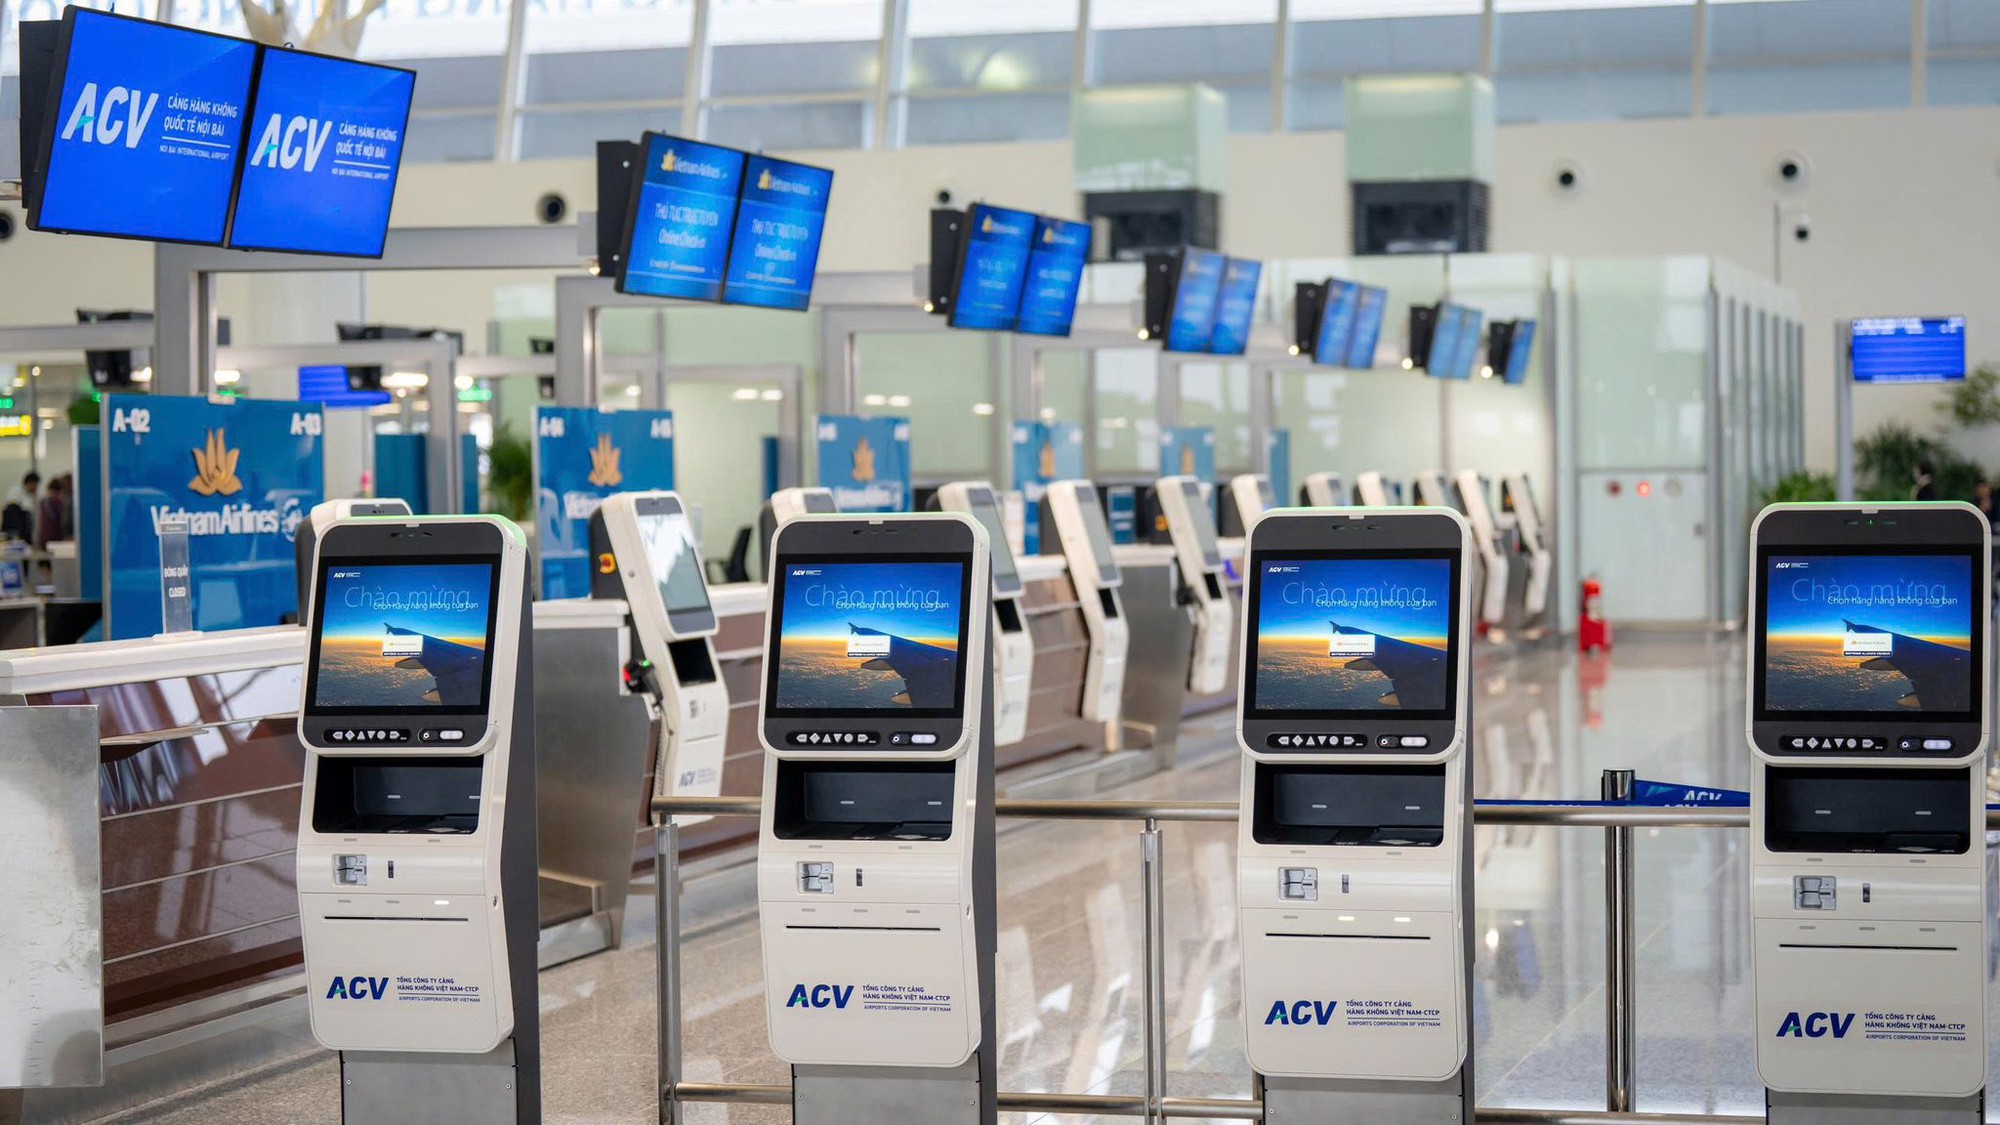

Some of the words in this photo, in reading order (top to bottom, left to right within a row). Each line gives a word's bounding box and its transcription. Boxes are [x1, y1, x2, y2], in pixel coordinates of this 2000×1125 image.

[61, 82, 159, 148] ACV
[250, 113, 333, 173] ACV
[112, 408, 150, 432] A-02
[221, 503, 279, 533] Airlines
[344, 584, 400, 608] Chào
[408, 584, 470, 612] mừng
[805, 584, 865, 607] Chào
[874, 583, 940, 612] mừng
[1282, 581, 1346, 605] Chào
[1356, 581, 1427, 610] mừng
[1791, 577, 1860, 602] Chào
[1871, 578, 1946, 608] mừng
[326, 976, 389, 1000] ACV
[396, 976, 412, 984] TỔNG
[414, 984, 434, 992] KHÔNG
[435, 984, 448, 992] VIỆT
[862, 983, 879, 992] TỔNG
[880, 984, 897, 992] CÔNG
[907, 984, 925, 993] CẢNG
[786, 983, 855, 1009] ACV
[862, 992, 880, 1000] HÀNG
[904, 993, 918, 1001] VIỆT
[1346, 998, 1363, 1007] TỔNG
[1365, 999, 1383, 1007] CÔNG
[1393, 999, 1412, 1008] CẢNG
[1264, 1000, 1337, 1026] ACV
[1346, 1007, 1365, 1015] HÀNG
[1366, 1008, 1389, 1016] KHÔNG
[1390, 1008, 1405, 1017] VIỆT
[1865, 1011, 1884, 1020] TỔNG
[1885, 1012, 1904, 1020] CÔNG
[1916, 1012, 1936, 1021] CẢNG
[1776, 1011, 1856, 1039] ACV
[1886, 1021, 1911, 1029] KHÔNG
[1912, 1022, 1928, 1030] VIỆT
